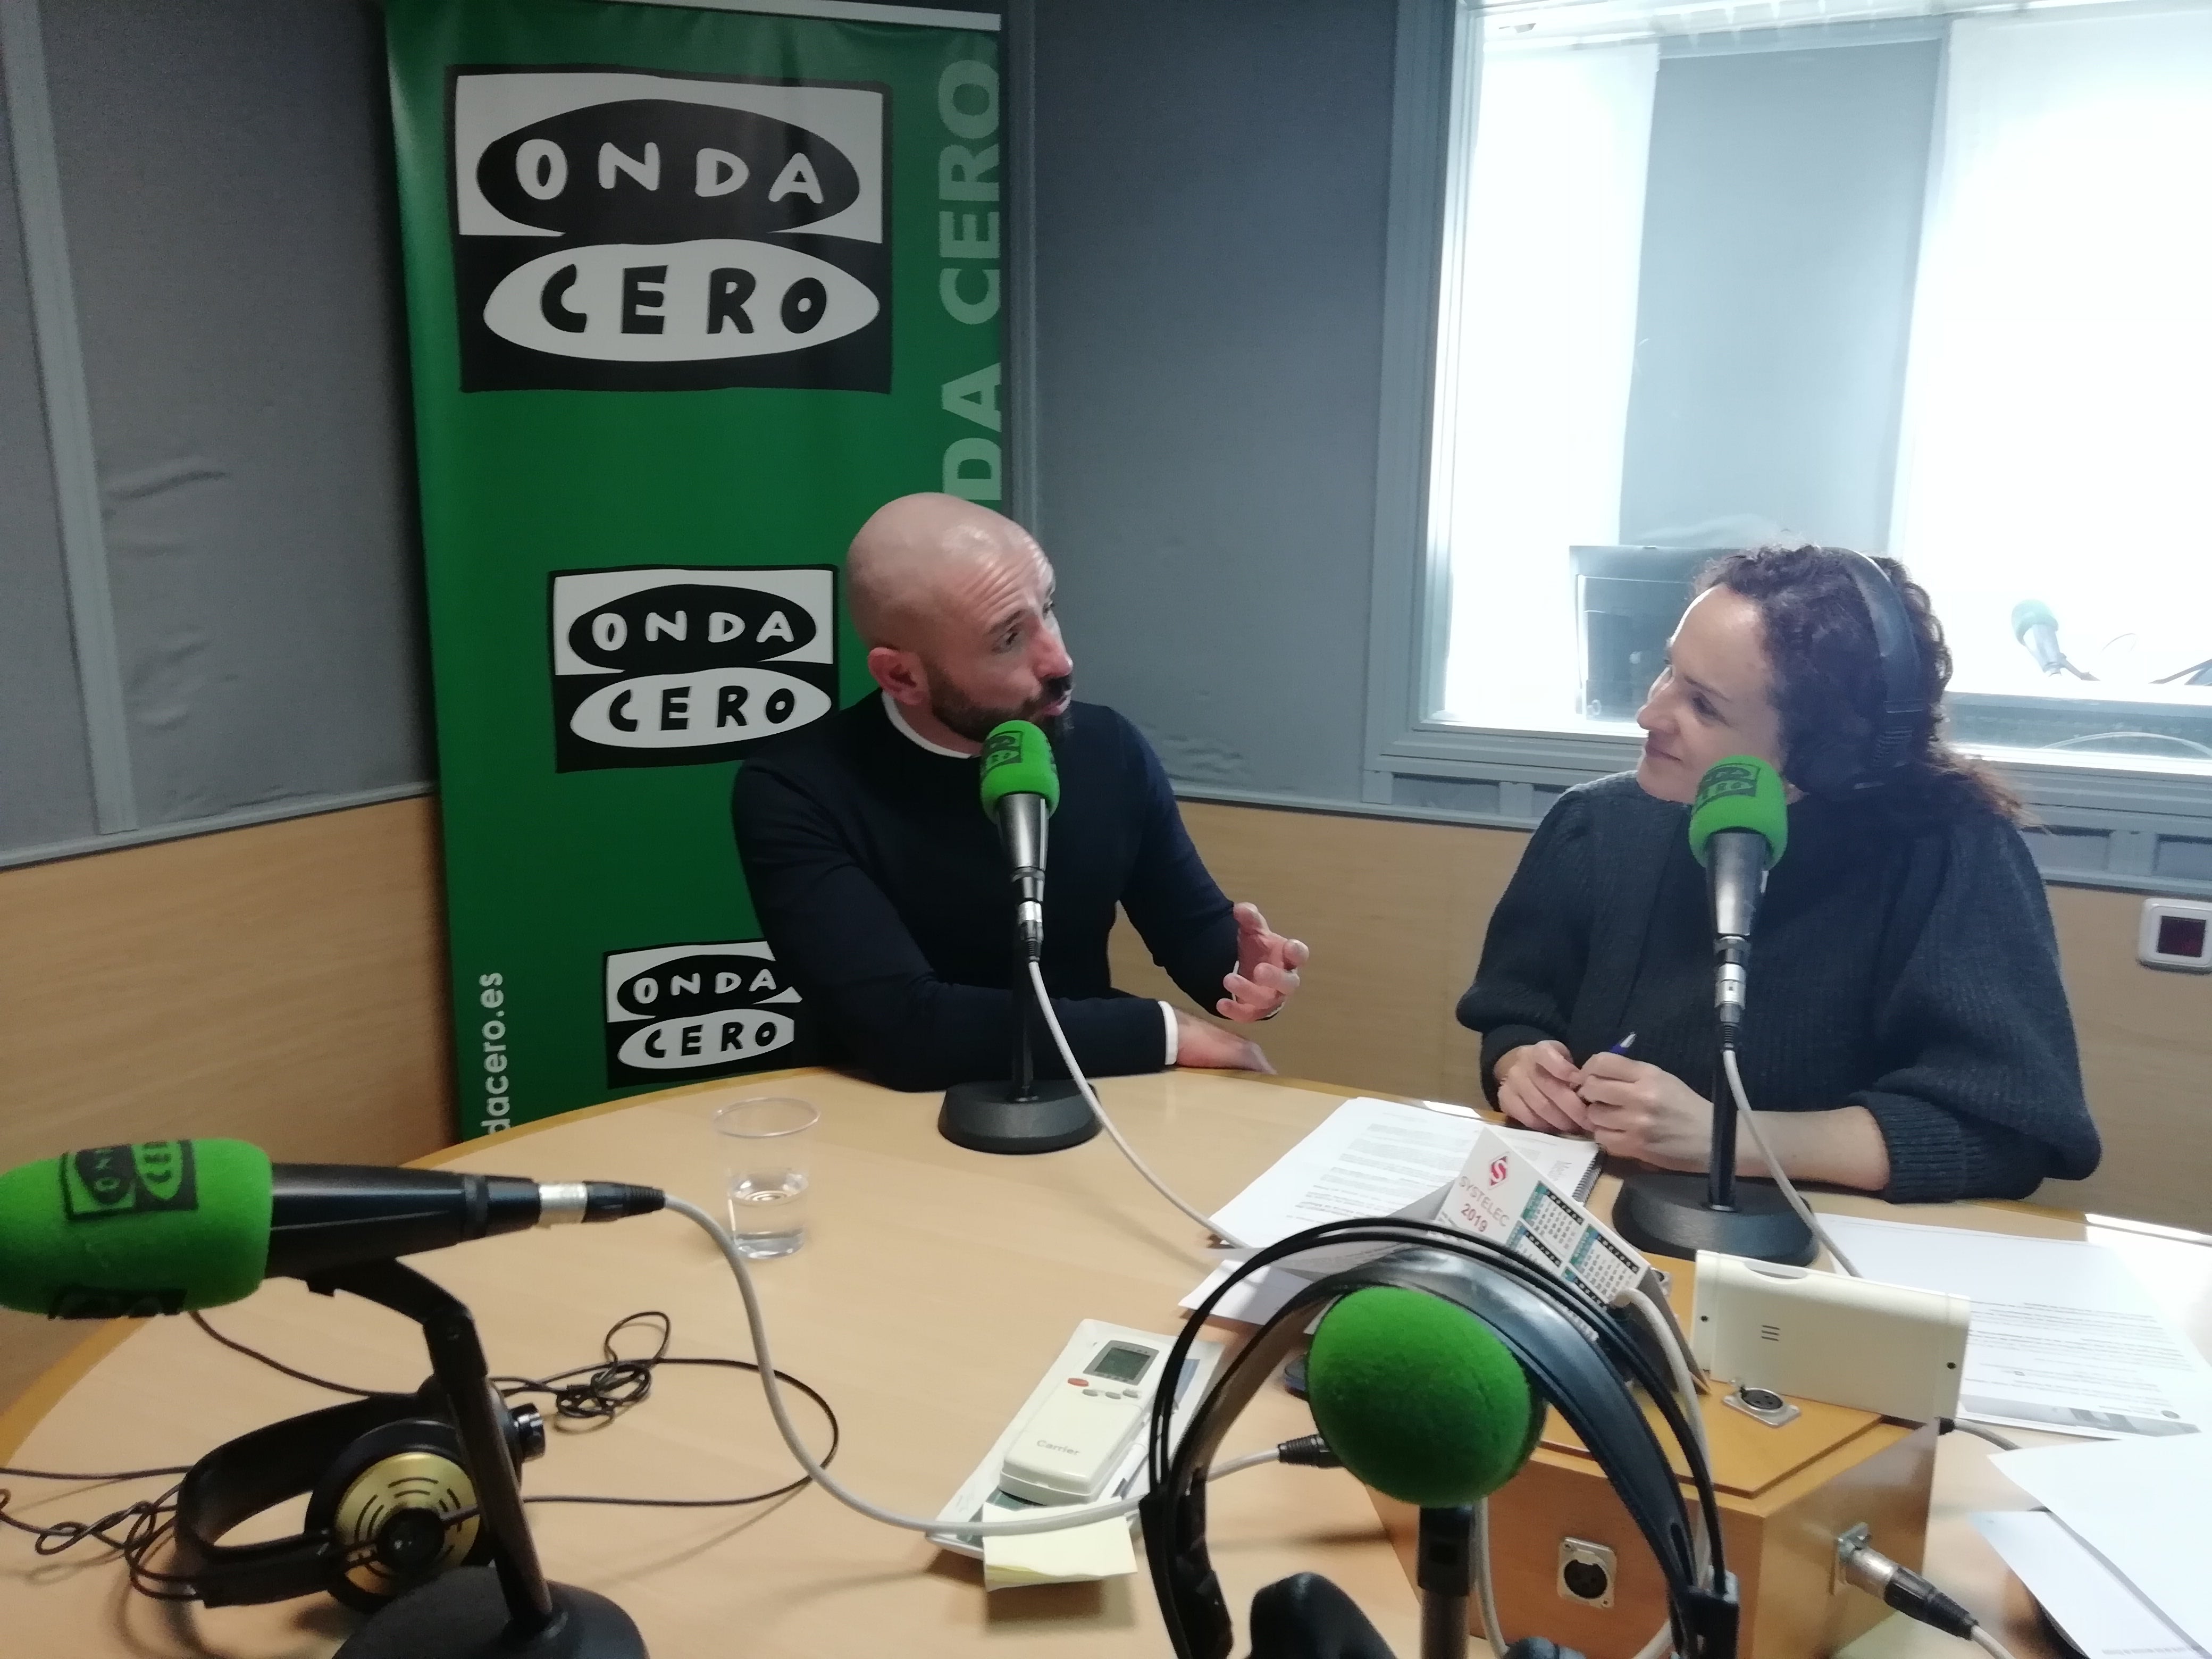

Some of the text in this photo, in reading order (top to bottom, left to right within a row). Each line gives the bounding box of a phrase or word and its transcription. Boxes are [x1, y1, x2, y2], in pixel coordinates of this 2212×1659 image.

[515, 138, 824, 204] ONDA
[938, 60, 1001, 325] CERO
[541, 263, 827, 335] CERO
[592, 610, 794, 651] ONDA
[608, 685, 797, 733] CERO
[633, 968, 777, 1004] ONDA
[645, 1020, 777, 1058] CERO
[1459, 1176, 1510, 1227] SYSTELEC
[1461, 1203, 1488, 1233] 2019
[1037, 1439, 1081, 1455] Carrier
